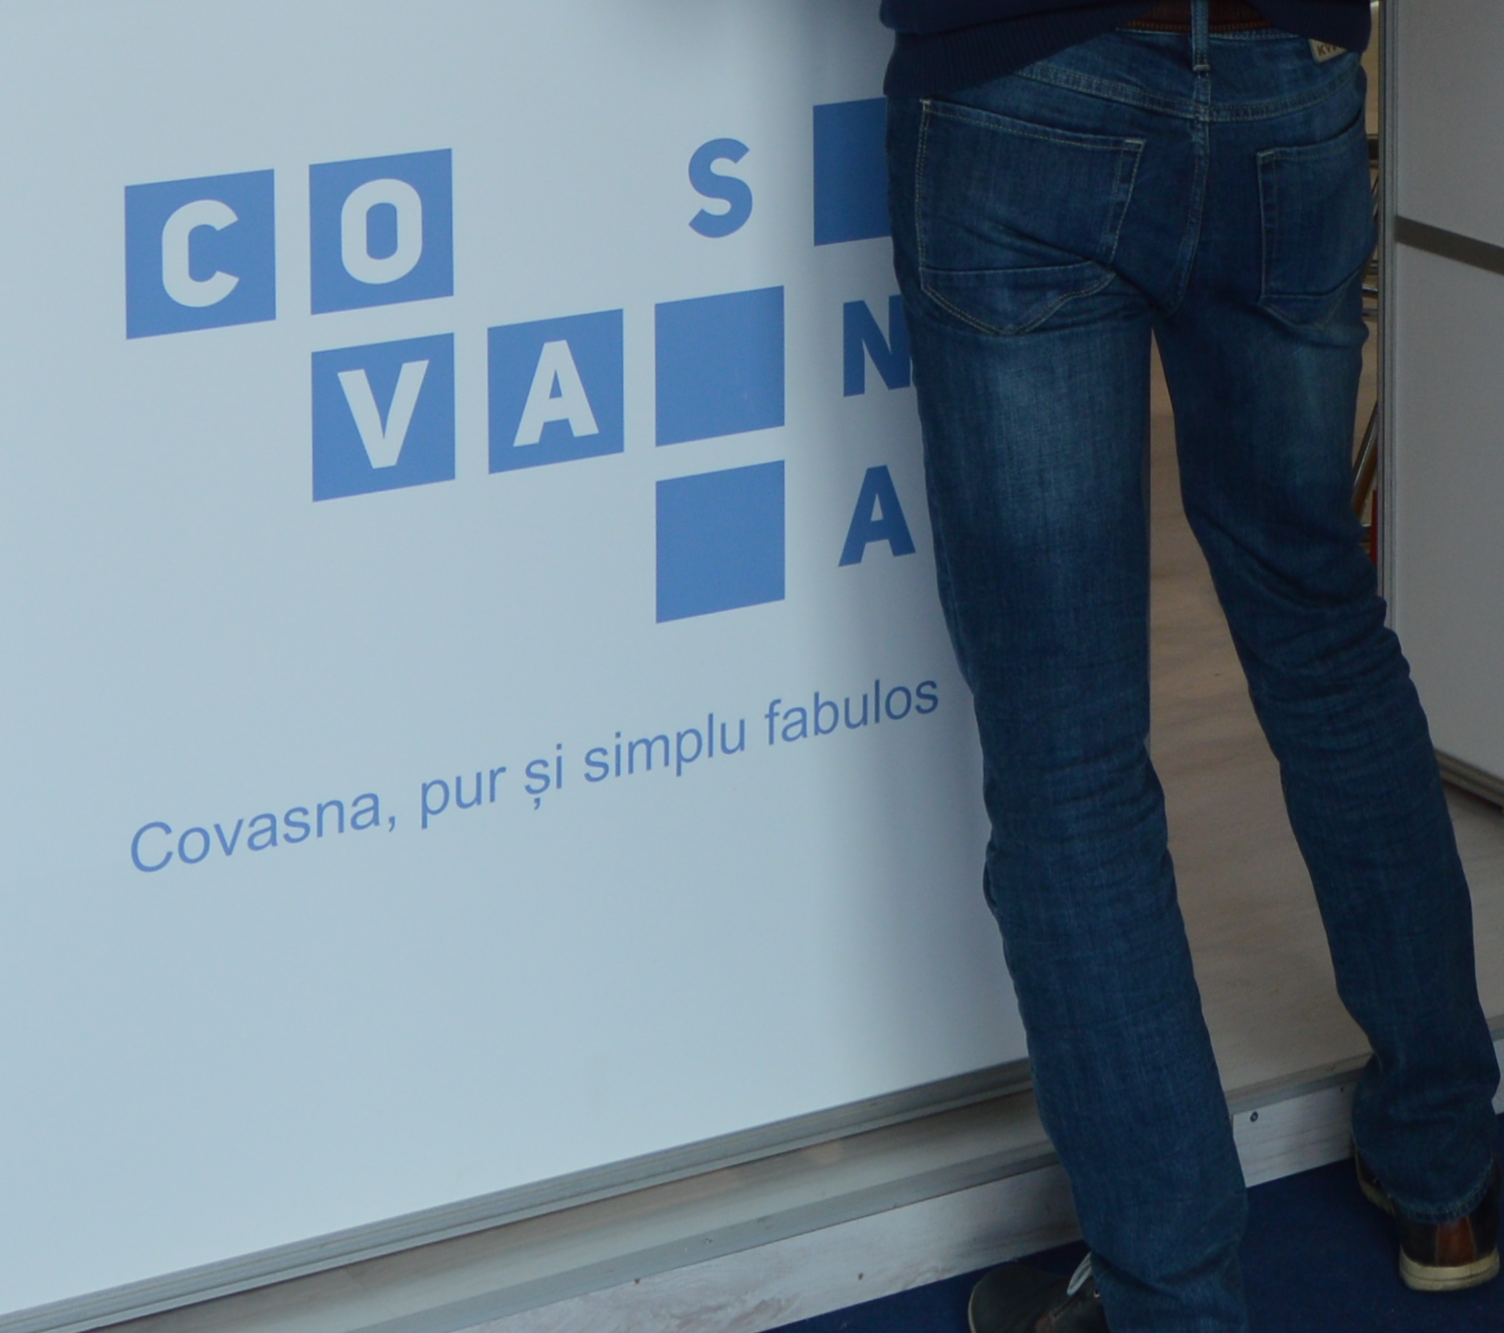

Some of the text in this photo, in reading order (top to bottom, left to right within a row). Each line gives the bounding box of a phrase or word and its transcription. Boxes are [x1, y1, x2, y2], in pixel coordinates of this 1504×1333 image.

[129, 675, 940, 873] Covasna, pur și simplu fabulos
